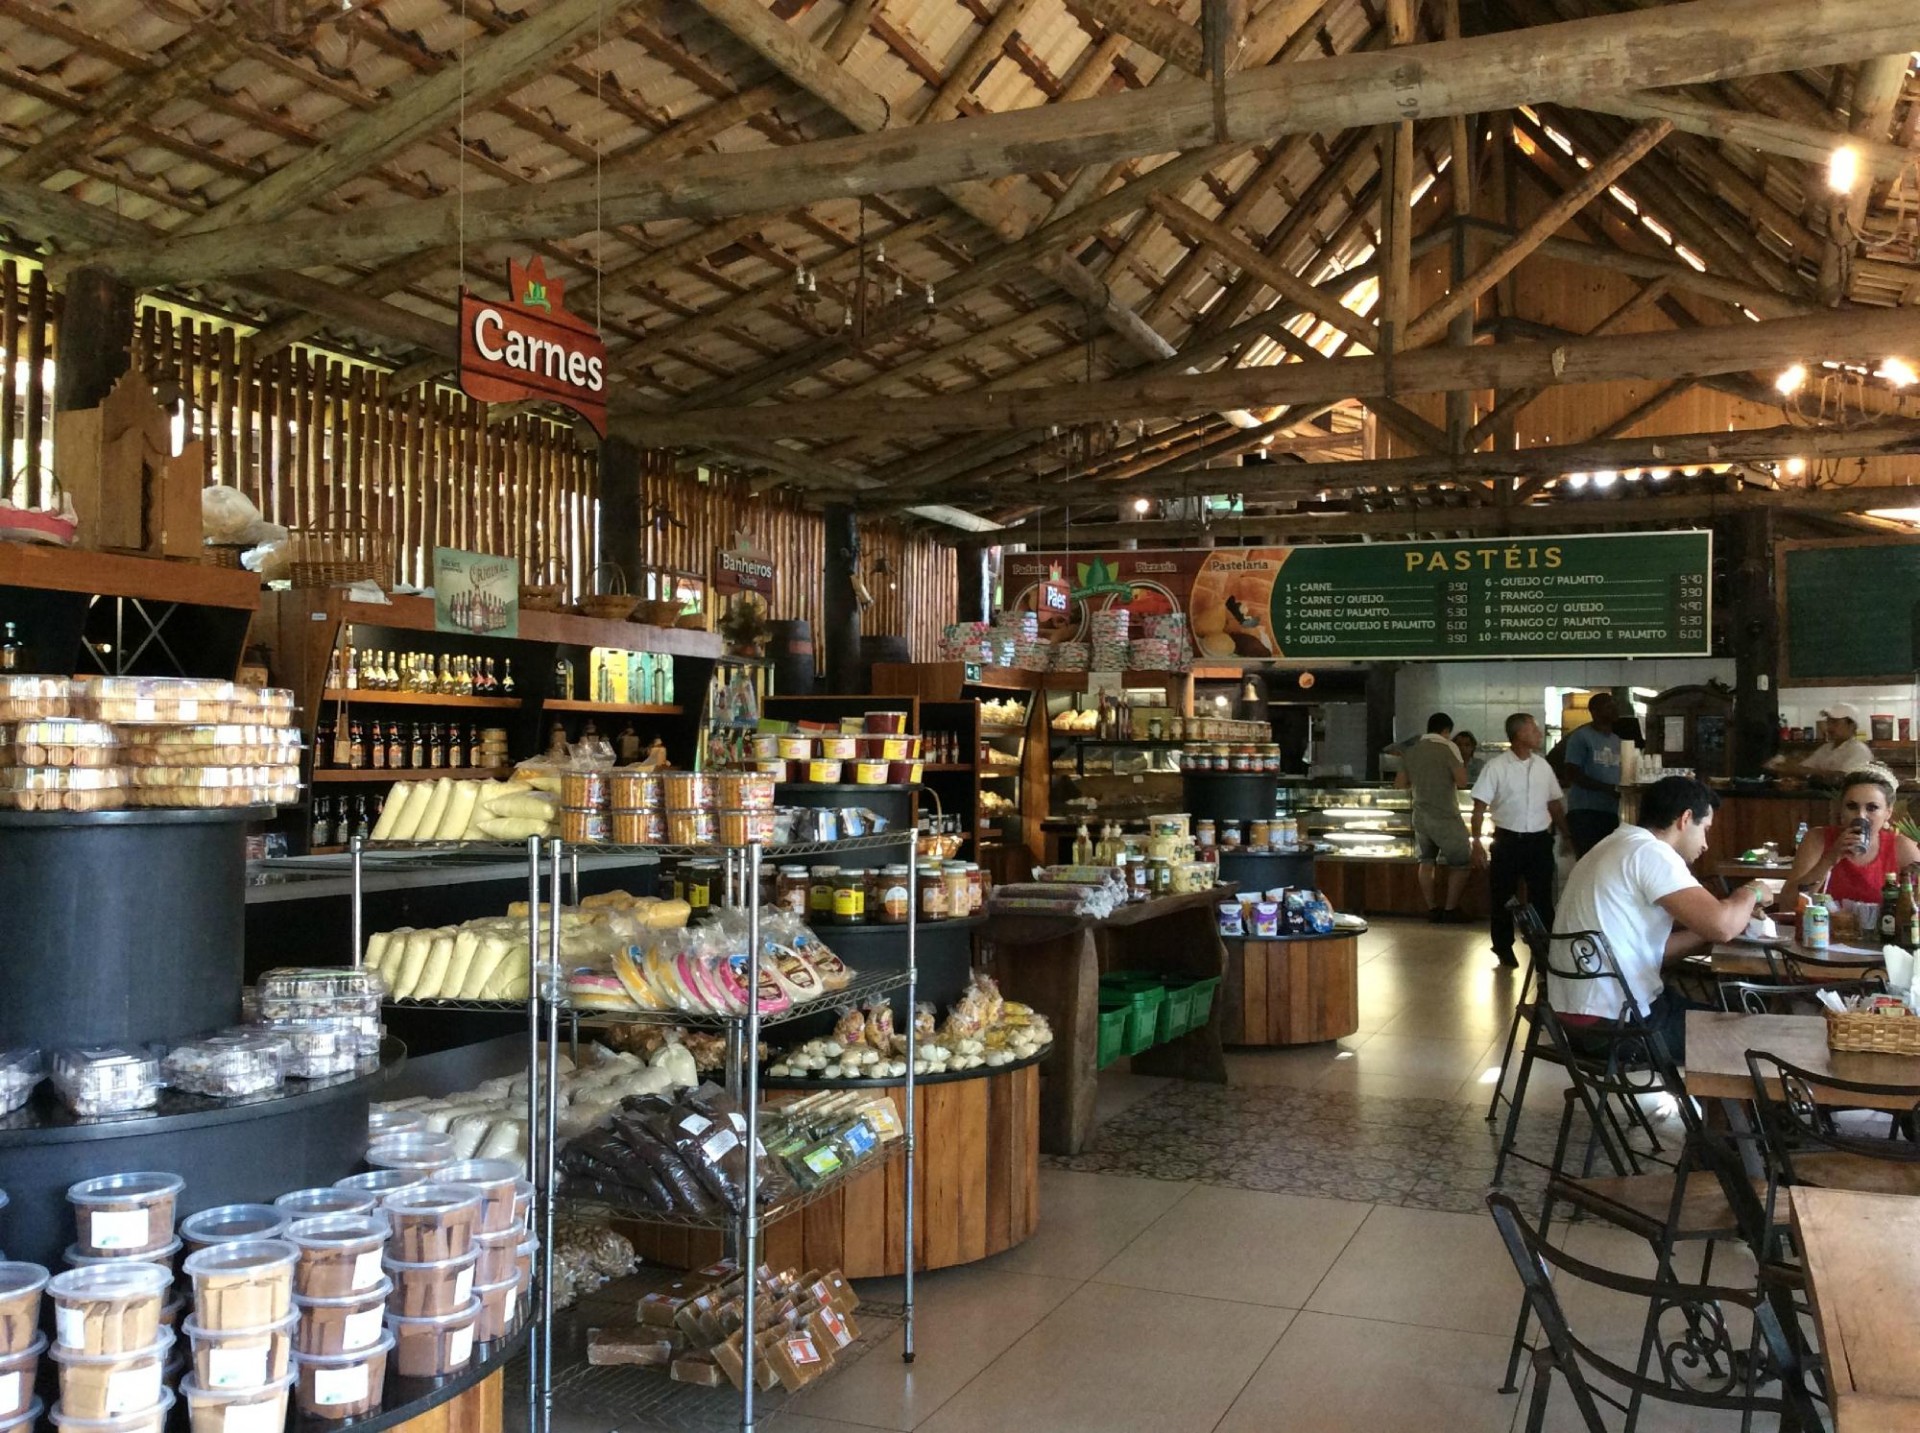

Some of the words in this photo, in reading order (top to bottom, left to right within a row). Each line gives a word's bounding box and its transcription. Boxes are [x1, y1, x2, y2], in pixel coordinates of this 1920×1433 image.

[475, 308, 603, 392] Carnes
[1404, 544, 1562, 572] PASTÉIS
[722, 553, 772, 578] Banheiros
[1212, 560, 1269, 572] Pastelaria
[1485, 578, 1491, 586] 6
[1501, 577, 1541, 586] QUEIJO
[1557, 575, 1604, 585] PALMITO
[1286, 583, 1291, 592] 1
[1300, 583, 1332, 591] CARNE
[1285, 596, 1291, 605] 2
[1300, 596, 1332, 604] CARNE
[1347, 594, 1384, 603] QUEIJO
[1485, 592, 1491, 600] 7
[1501, 590, 1544, 599] FRANGO
[1285, 610, 1291, 618] 3
[1300, 609, 1332, 617] CARNE
[1347, 608, 1390, 617] PALMITO
[1485, 605, 1491, 614] 8
[1501, 604, 1544, 613] FRANGO
[1563, 603, 1604, 612] QUEIJO
[1285, 622, 1291, 631] 4
[1300, 622, 1332, 630] CARNE
[1384, 621, 1389, 629] E
[1392, 620, 1435, 629] PALMITO
[1485, 620, 1491, 628] 9
[1501, 618, 1544, 627] FRANGO
[1563, 617, 1611, 626] PALMITO
[1285, 636, 1291, 644] 5
[1300, 635, 1336, 644] QUEIJO
[1479, 633, 1491, 641] 10
[1501, 632, 1544, 641] FRANGO
[1560, 631, 1601, 640] QUEIJO
[1607, 630, 1613, 639] E
[1619, 629, 1667, 639] PALMITO
